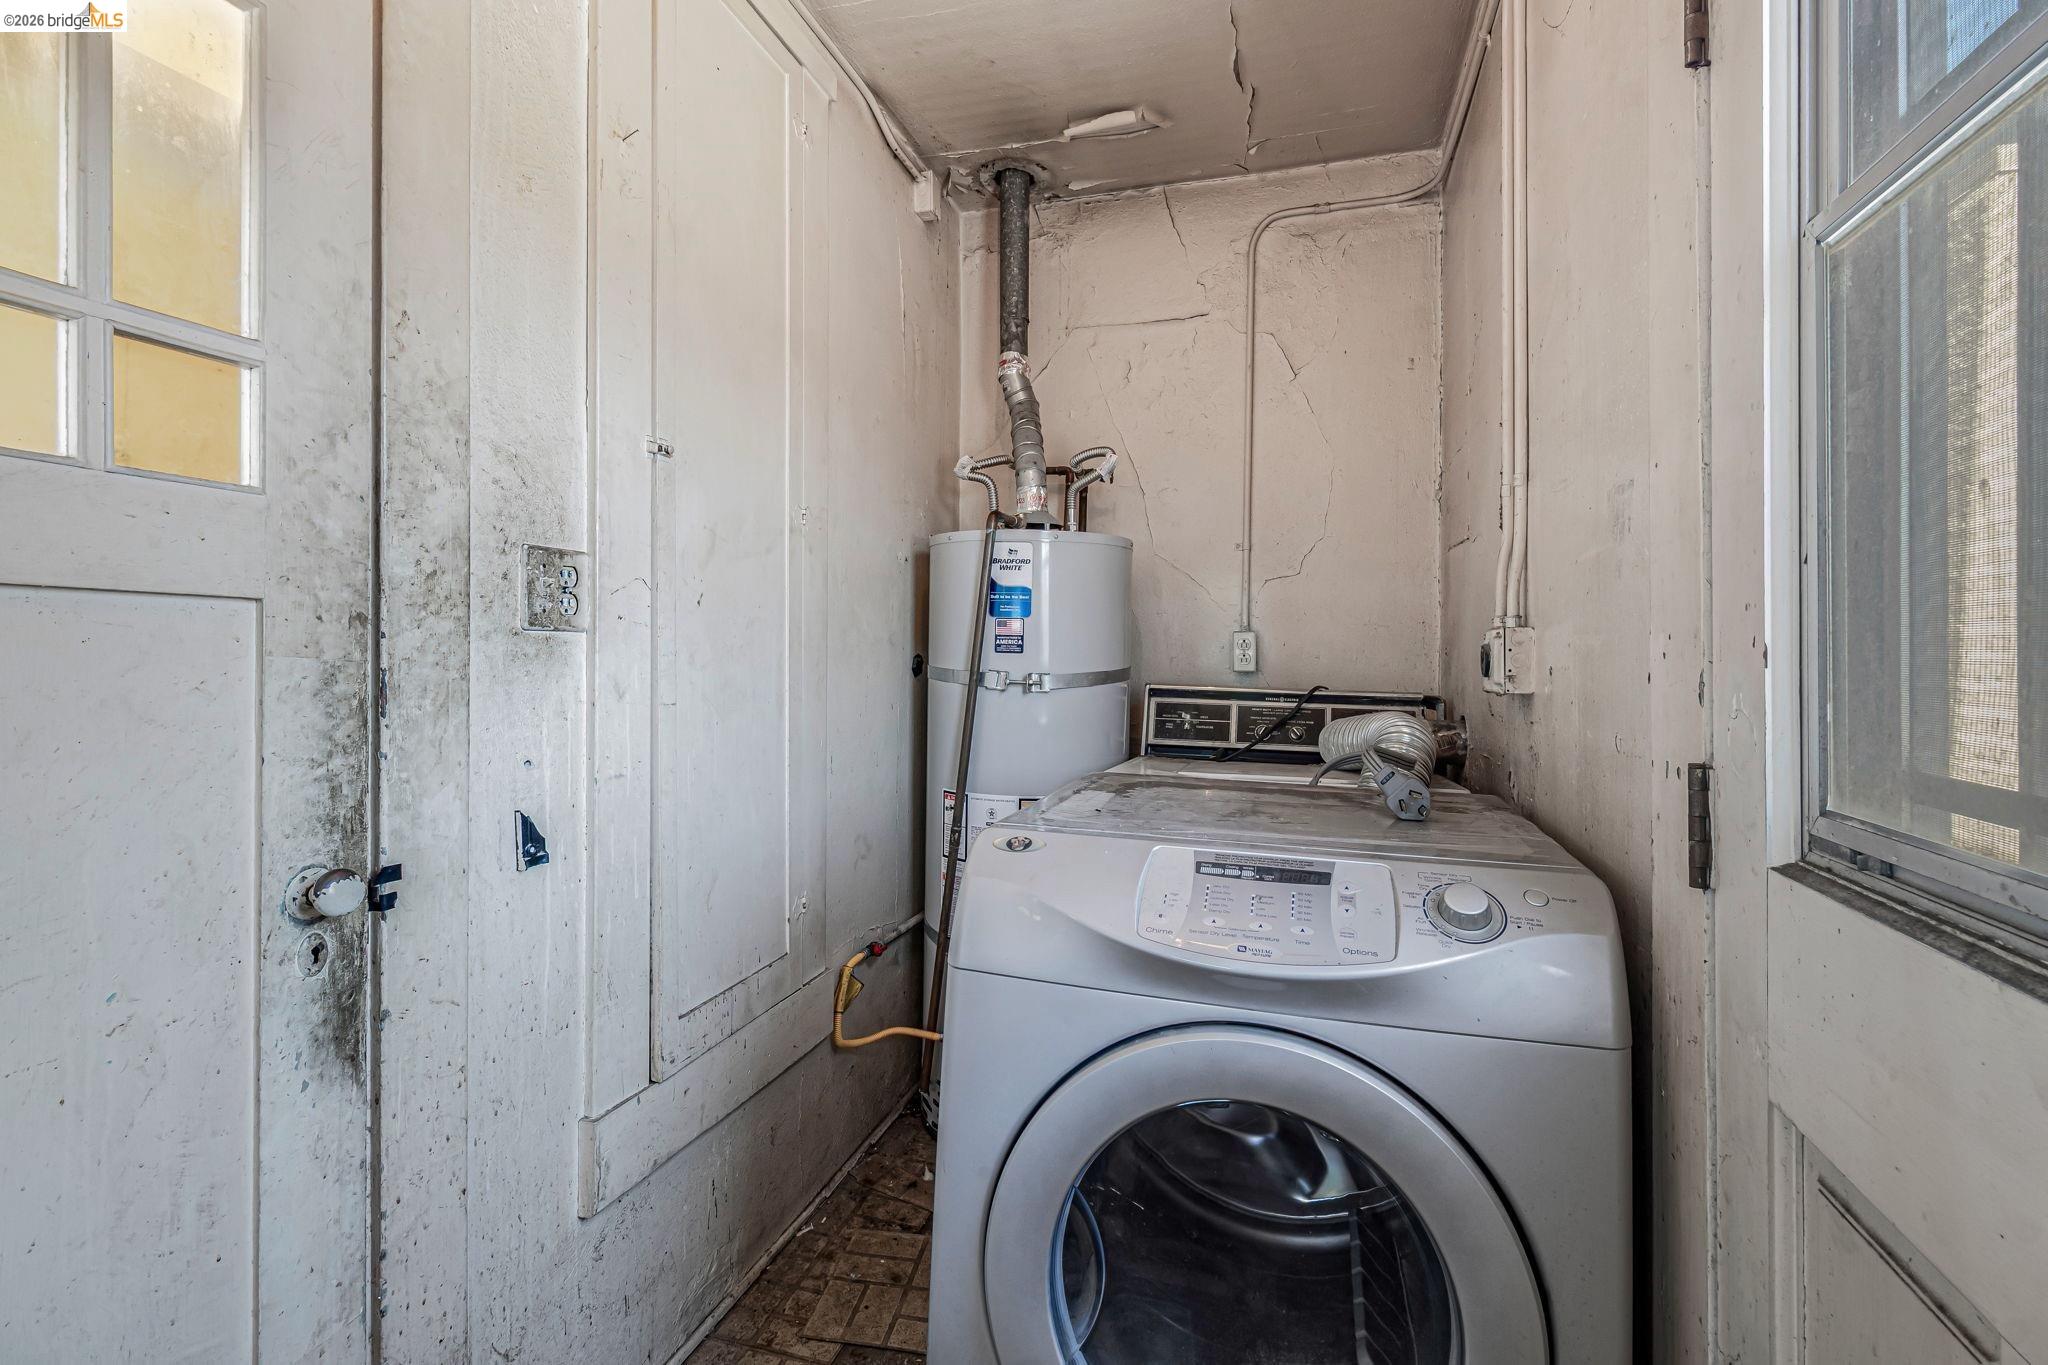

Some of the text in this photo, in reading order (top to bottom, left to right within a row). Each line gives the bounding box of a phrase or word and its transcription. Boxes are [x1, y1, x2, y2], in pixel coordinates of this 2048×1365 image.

[1145, 926, 1174, 935] Chime
[1247, 947, 1273, 955] MAYTAG
[1342, 947, 1379, 957] Options
